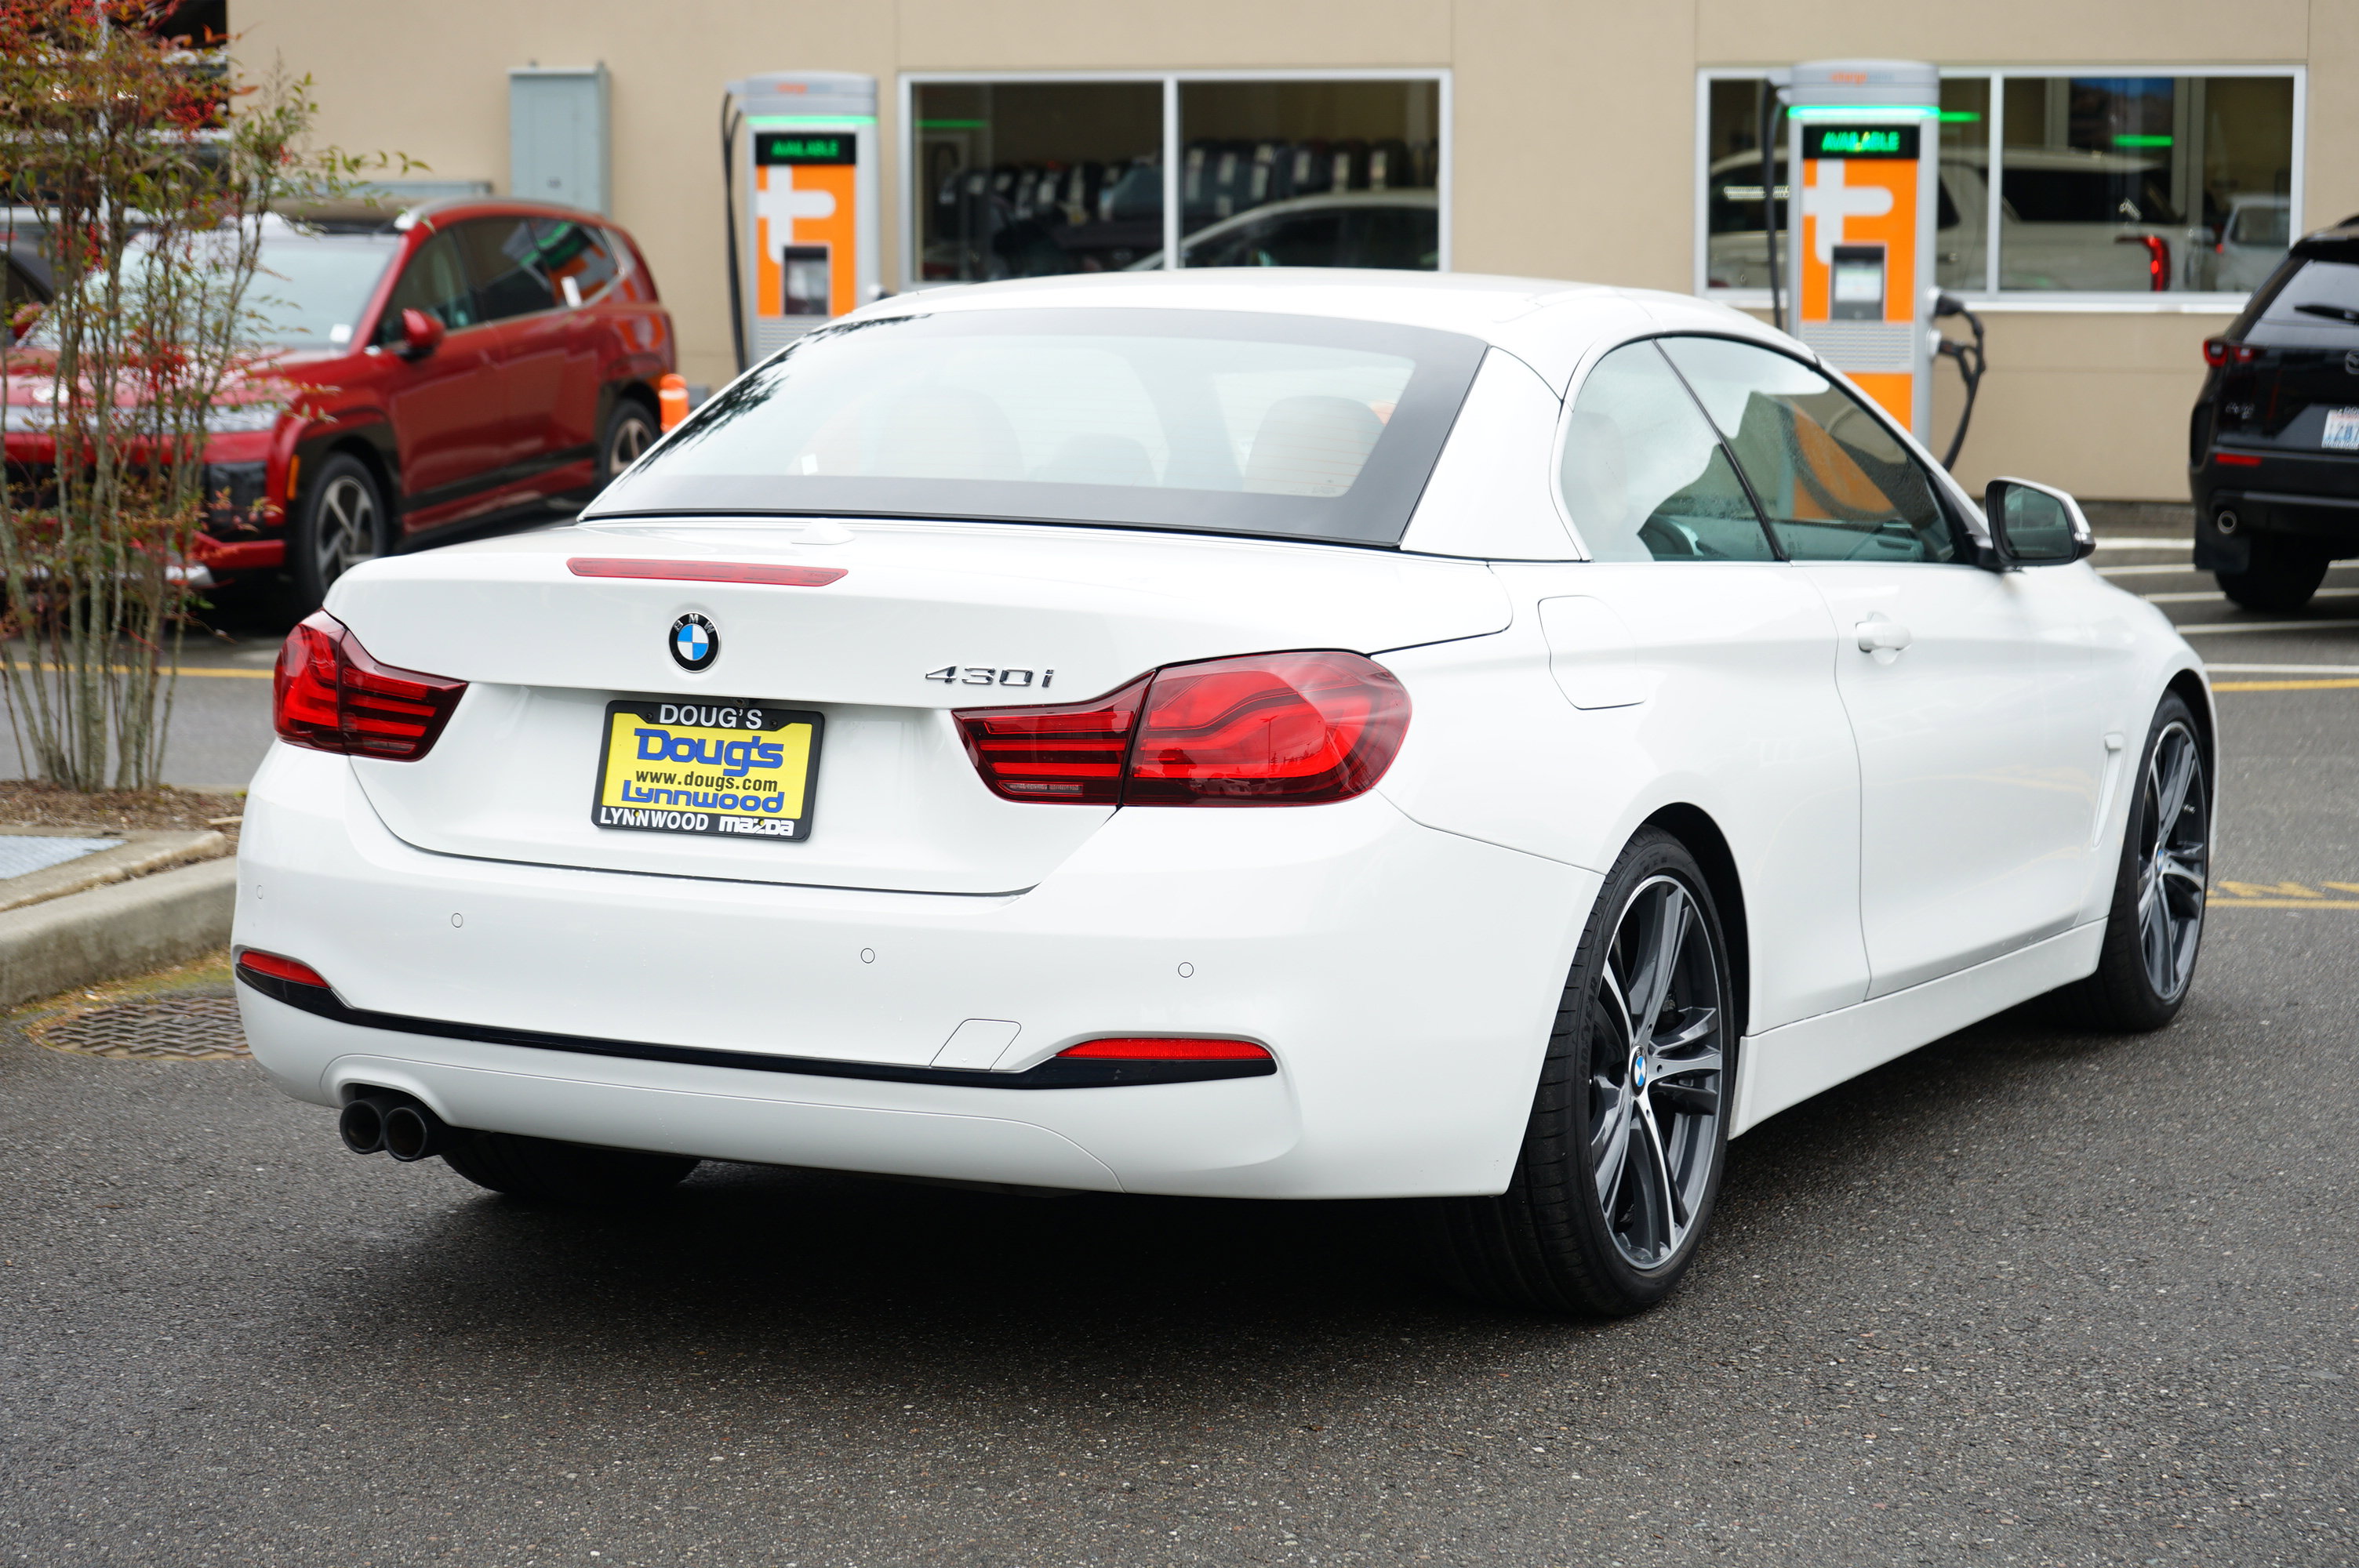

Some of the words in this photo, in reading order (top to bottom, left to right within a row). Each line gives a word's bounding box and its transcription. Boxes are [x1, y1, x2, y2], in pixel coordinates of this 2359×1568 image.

[771, 140, 838, 157] AVAILABLE
[1822, 131, 1899, 152] AVAILABLE
[673, 613, 715, 633] BMW
[925, 665, 1054, 688] 430i
[660, 704, 762, 730] DOUG'S
[635, 771, 778, 793] www.dougs.com
[621, 780, 784, 813] Lynnwood
[600, 807, 709, 831] LYNNWOOD
